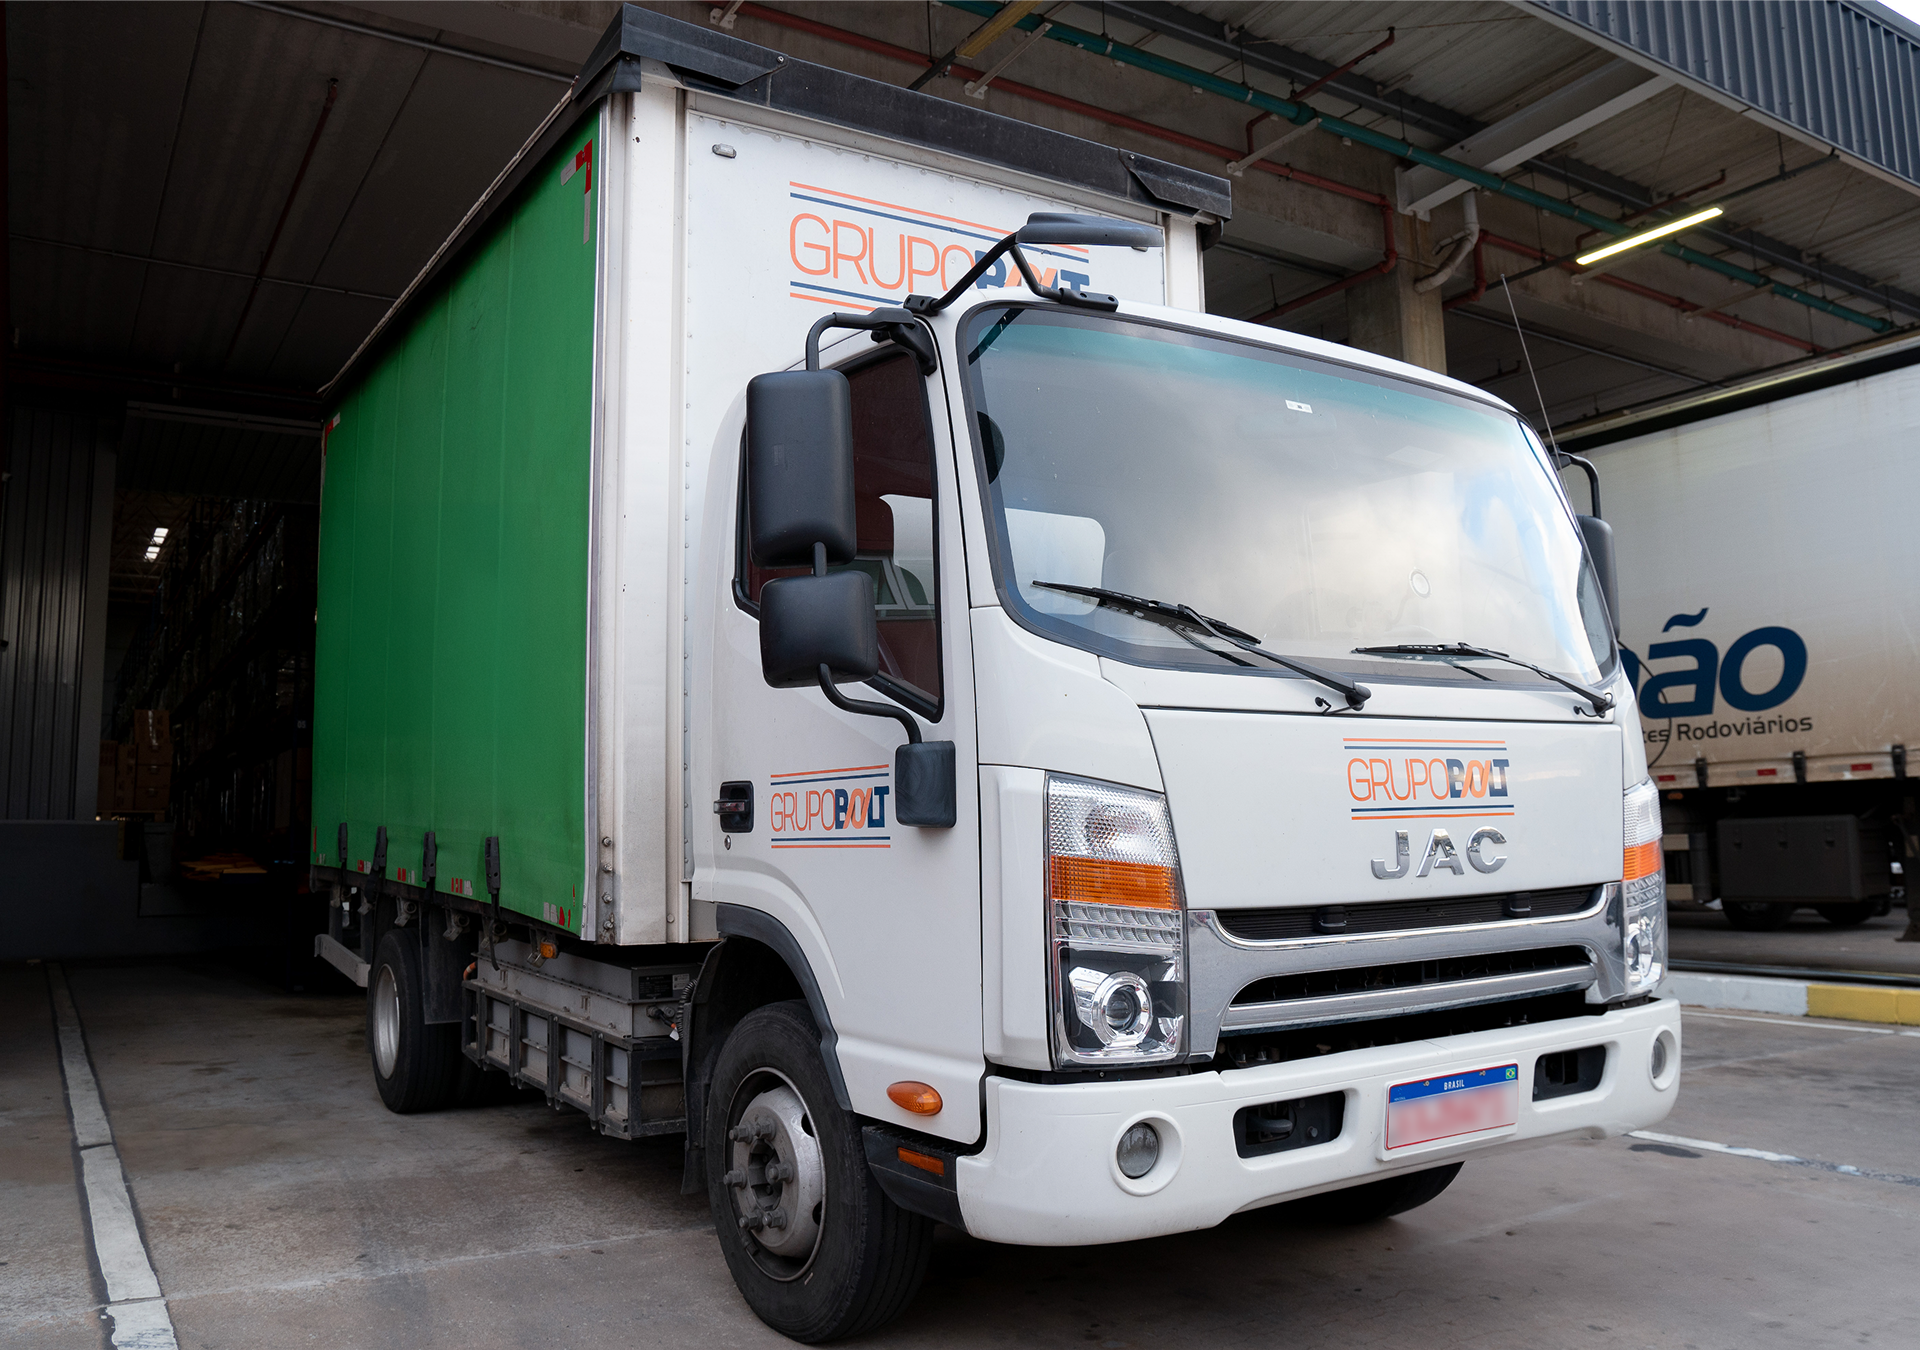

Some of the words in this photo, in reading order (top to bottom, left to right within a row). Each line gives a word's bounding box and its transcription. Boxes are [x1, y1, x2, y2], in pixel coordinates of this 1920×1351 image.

[1619, 607, 1808, 719] ão
[1677, 714, 1813, 741] Rodoviários
[1371, 825, 1508, 880] JAC
[1443, 1079, 1465, 1090] BRASIL
